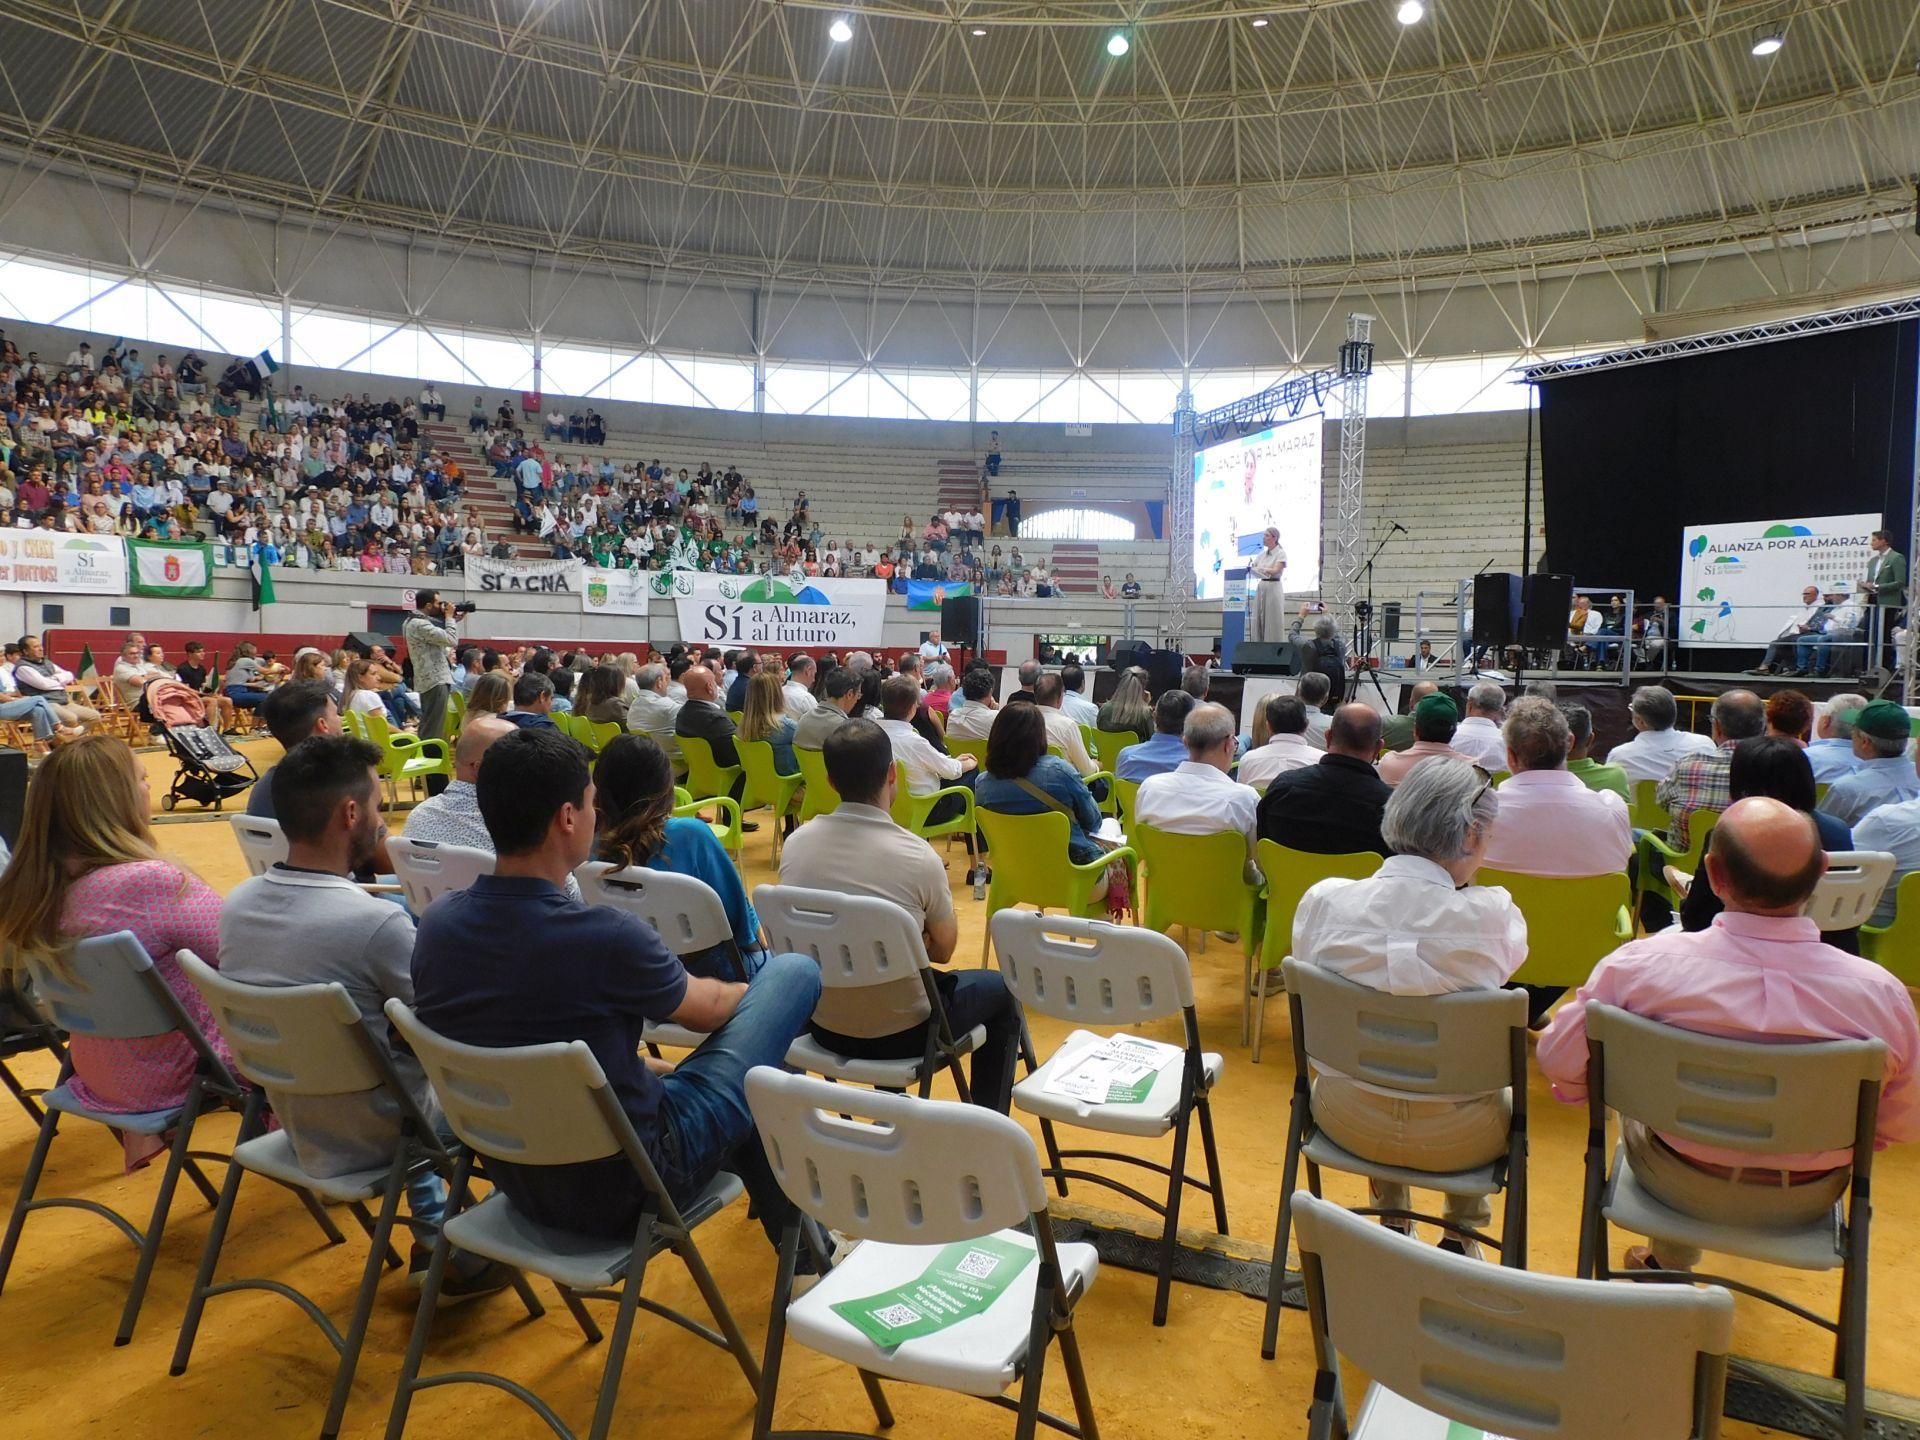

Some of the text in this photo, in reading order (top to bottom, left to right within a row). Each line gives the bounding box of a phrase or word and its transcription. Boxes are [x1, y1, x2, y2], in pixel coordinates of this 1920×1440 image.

[1266, 432, 1315, 457] ALMARAZ
[1708, 536, 1869, 553] ALIANZA POR ALMARAZ
[77, 552, 96, 568] Sí
[80, 576, 108, 584] futuro
[510, 576, 522, 589] A
[525, 573, 570, 592] CNA
[703, 604, 856, 641] Sí a Almaraz,
[751, 624, 836, 642] al futuro
